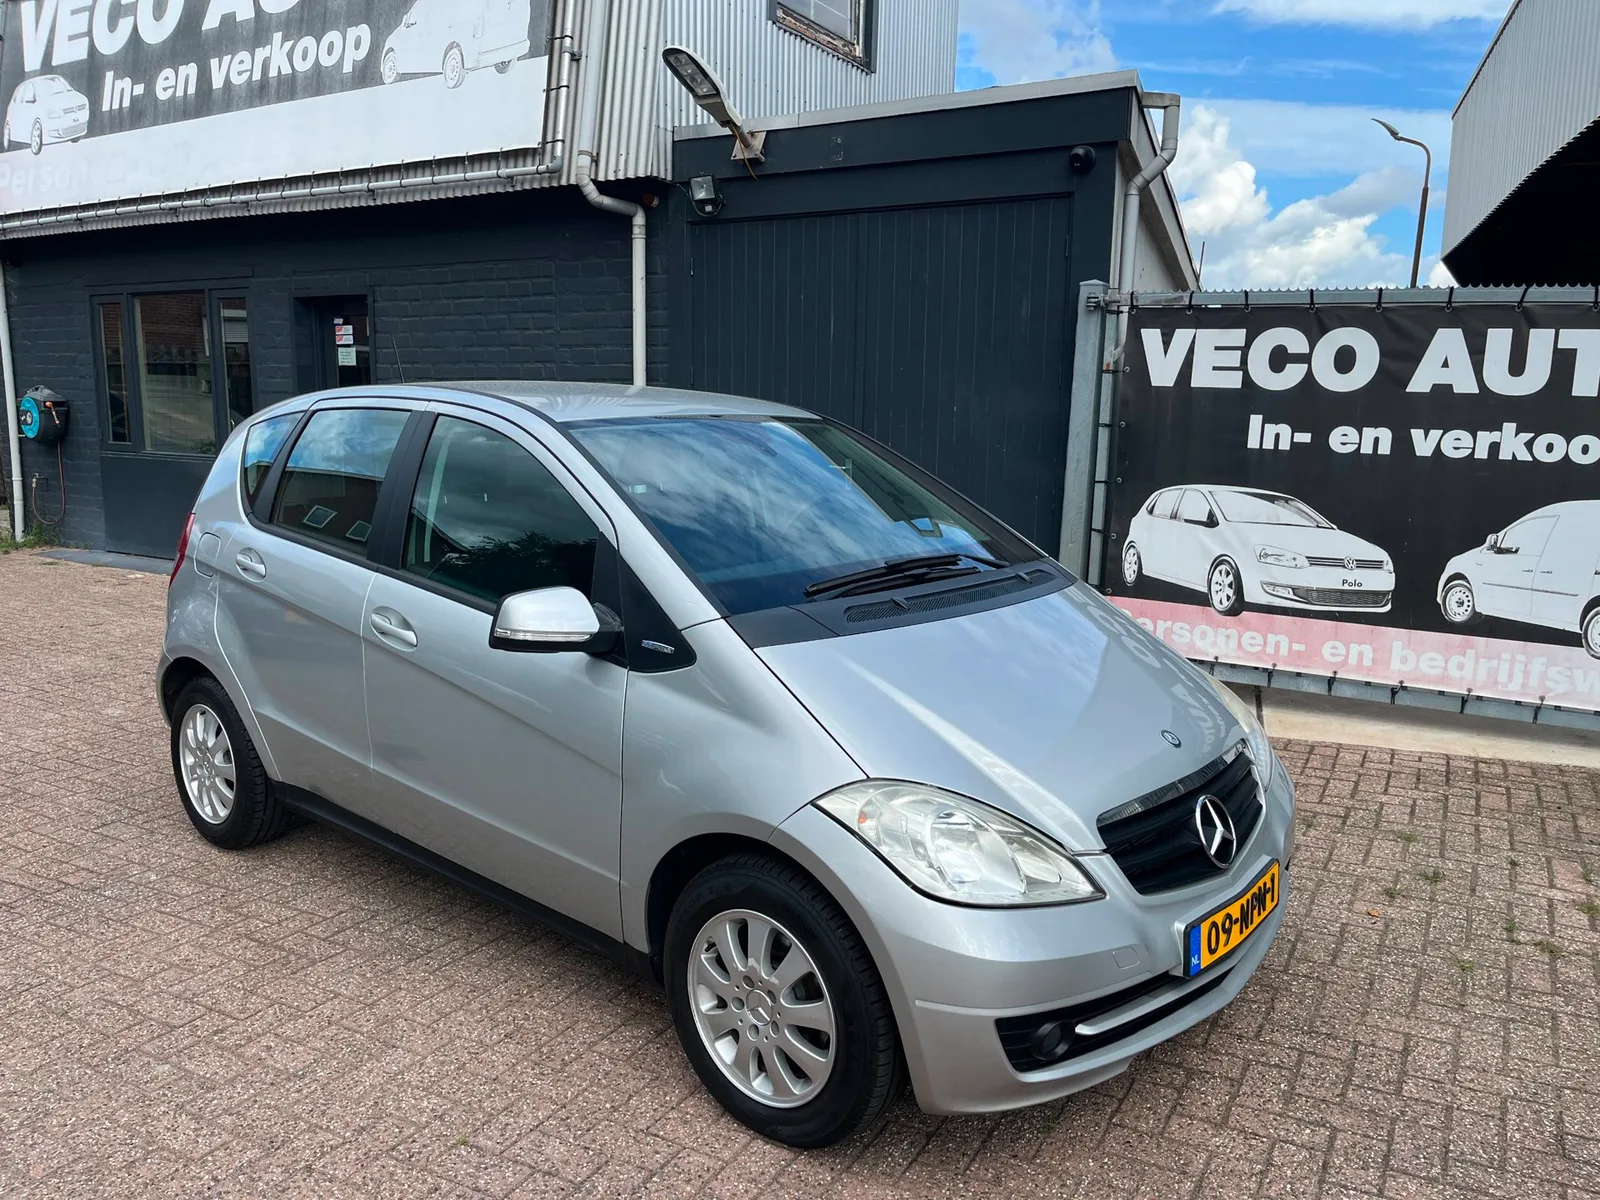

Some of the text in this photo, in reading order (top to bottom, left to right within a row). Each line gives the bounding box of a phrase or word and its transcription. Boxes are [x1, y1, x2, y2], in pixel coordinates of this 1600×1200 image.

[20, 0, 186, 72] VECO
[101, 23, 371, 112] In- en verkoop
[1140, 326, 1381, 392] VECO
[1247, 414, 1600, 465] In- en verkoo
[1341, 578, 1363, 588] Polo
[1322, 637, 1373, 667] en
[1207, 872, 1276, 956] 09-NPN-1
[1191, 954, 1199, 966] NL
